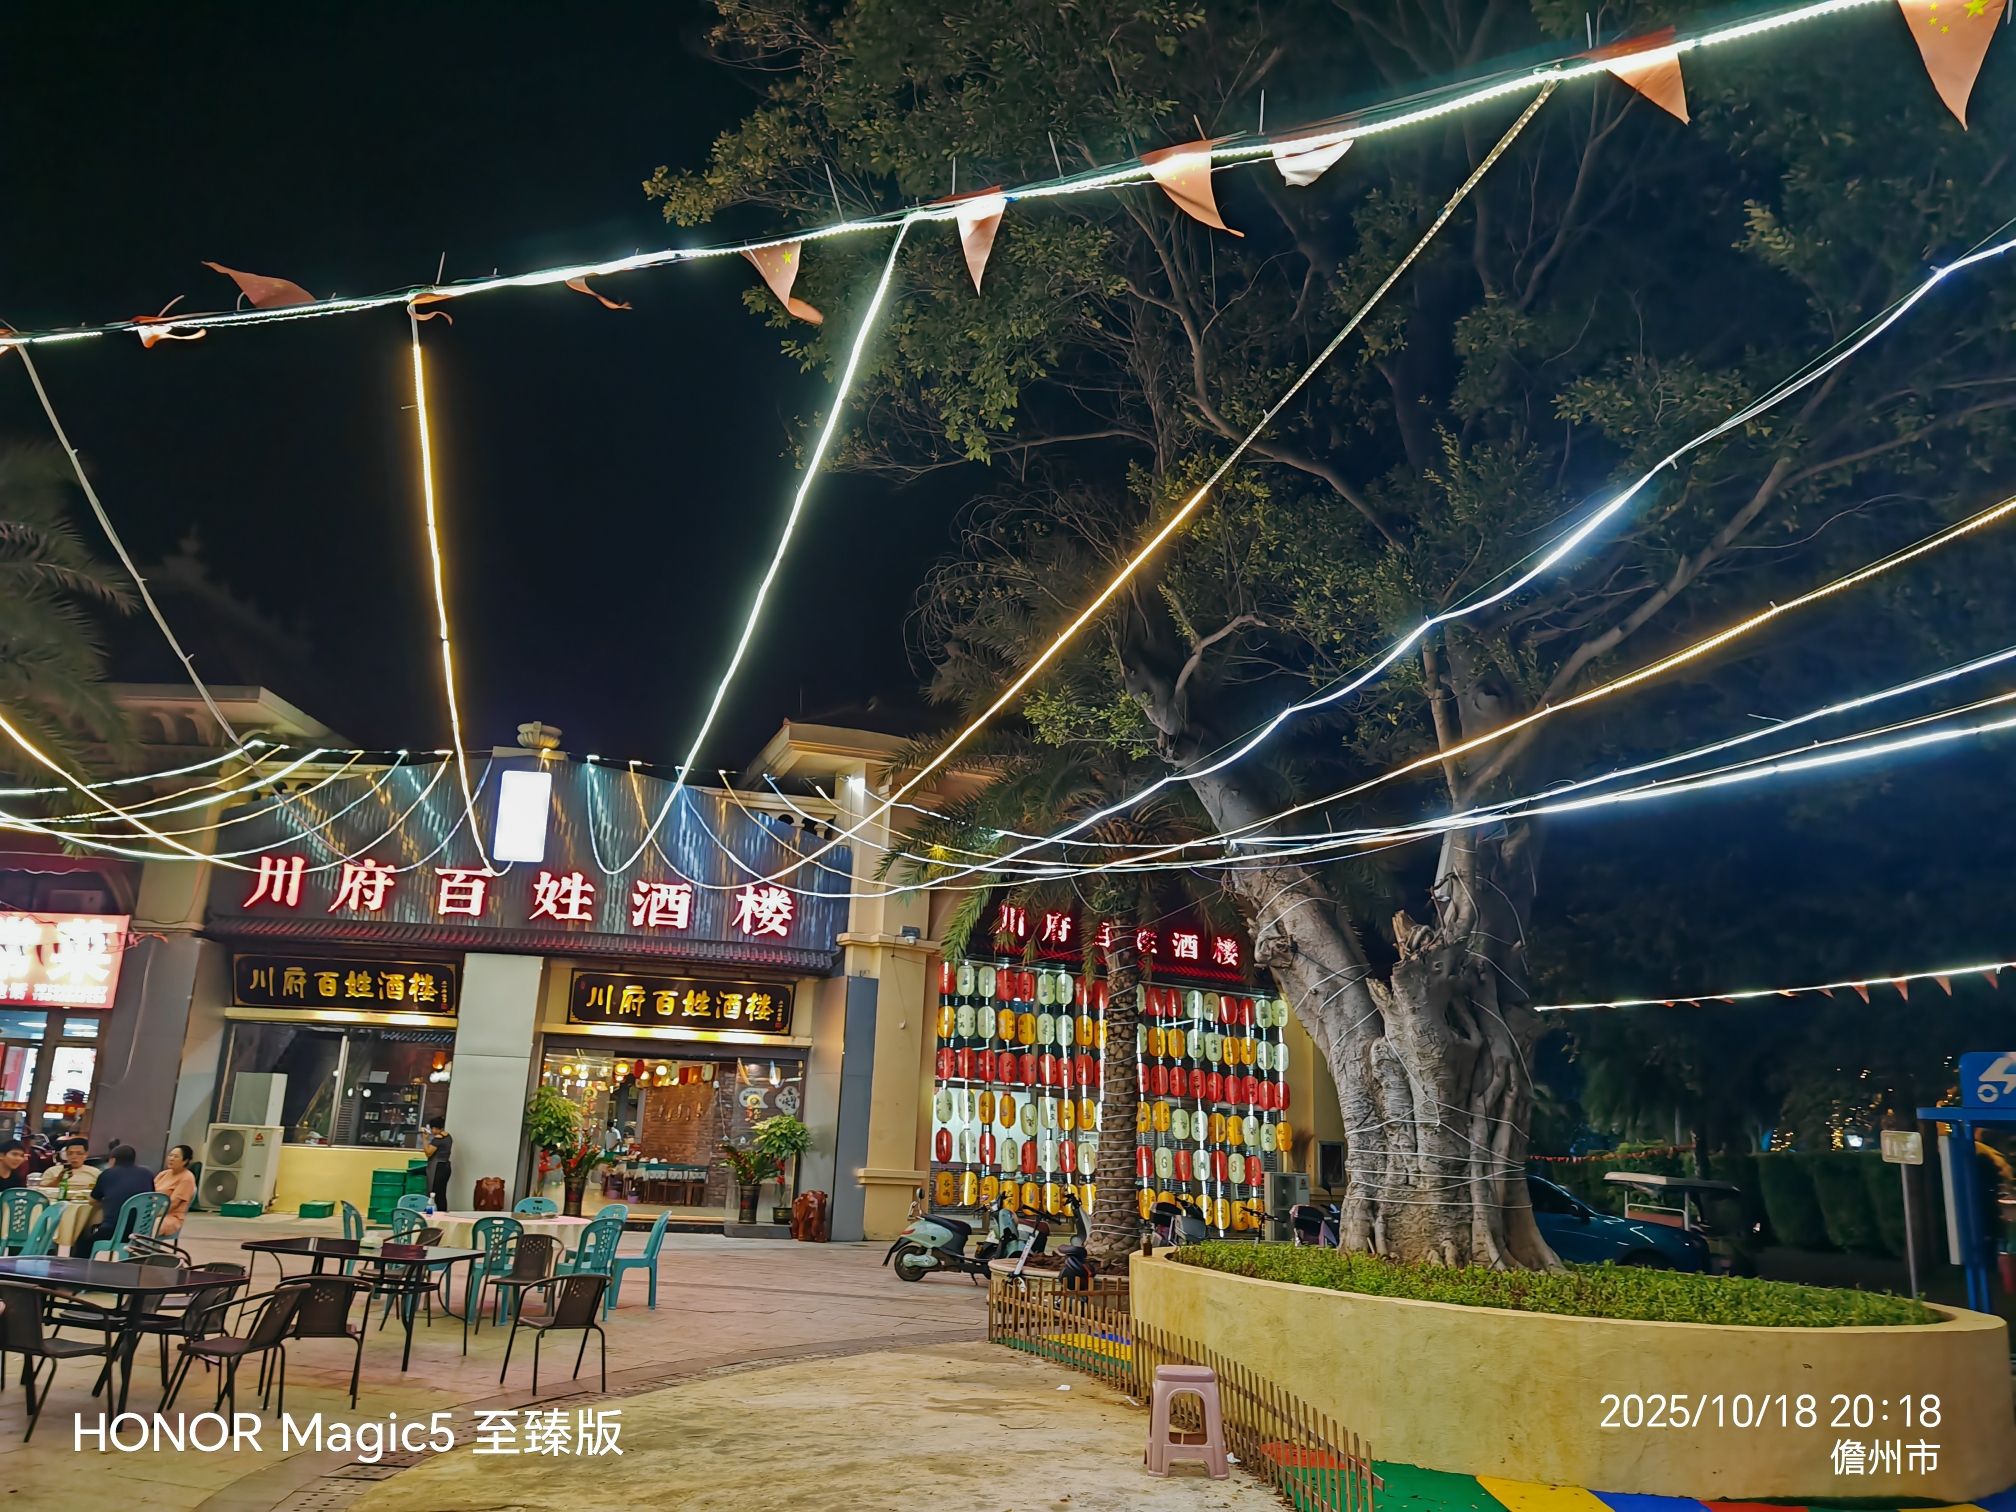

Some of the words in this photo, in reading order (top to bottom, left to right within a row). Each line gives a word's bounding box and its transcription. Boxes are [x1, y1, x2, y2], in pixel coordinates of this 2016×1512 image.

[244, 856, 794, 937] 川府百姓酒楼
[249, 966, 438, 1003] 川府百姓酒楼
[586, 984, 775, 1022] 川府百姓酒楼
